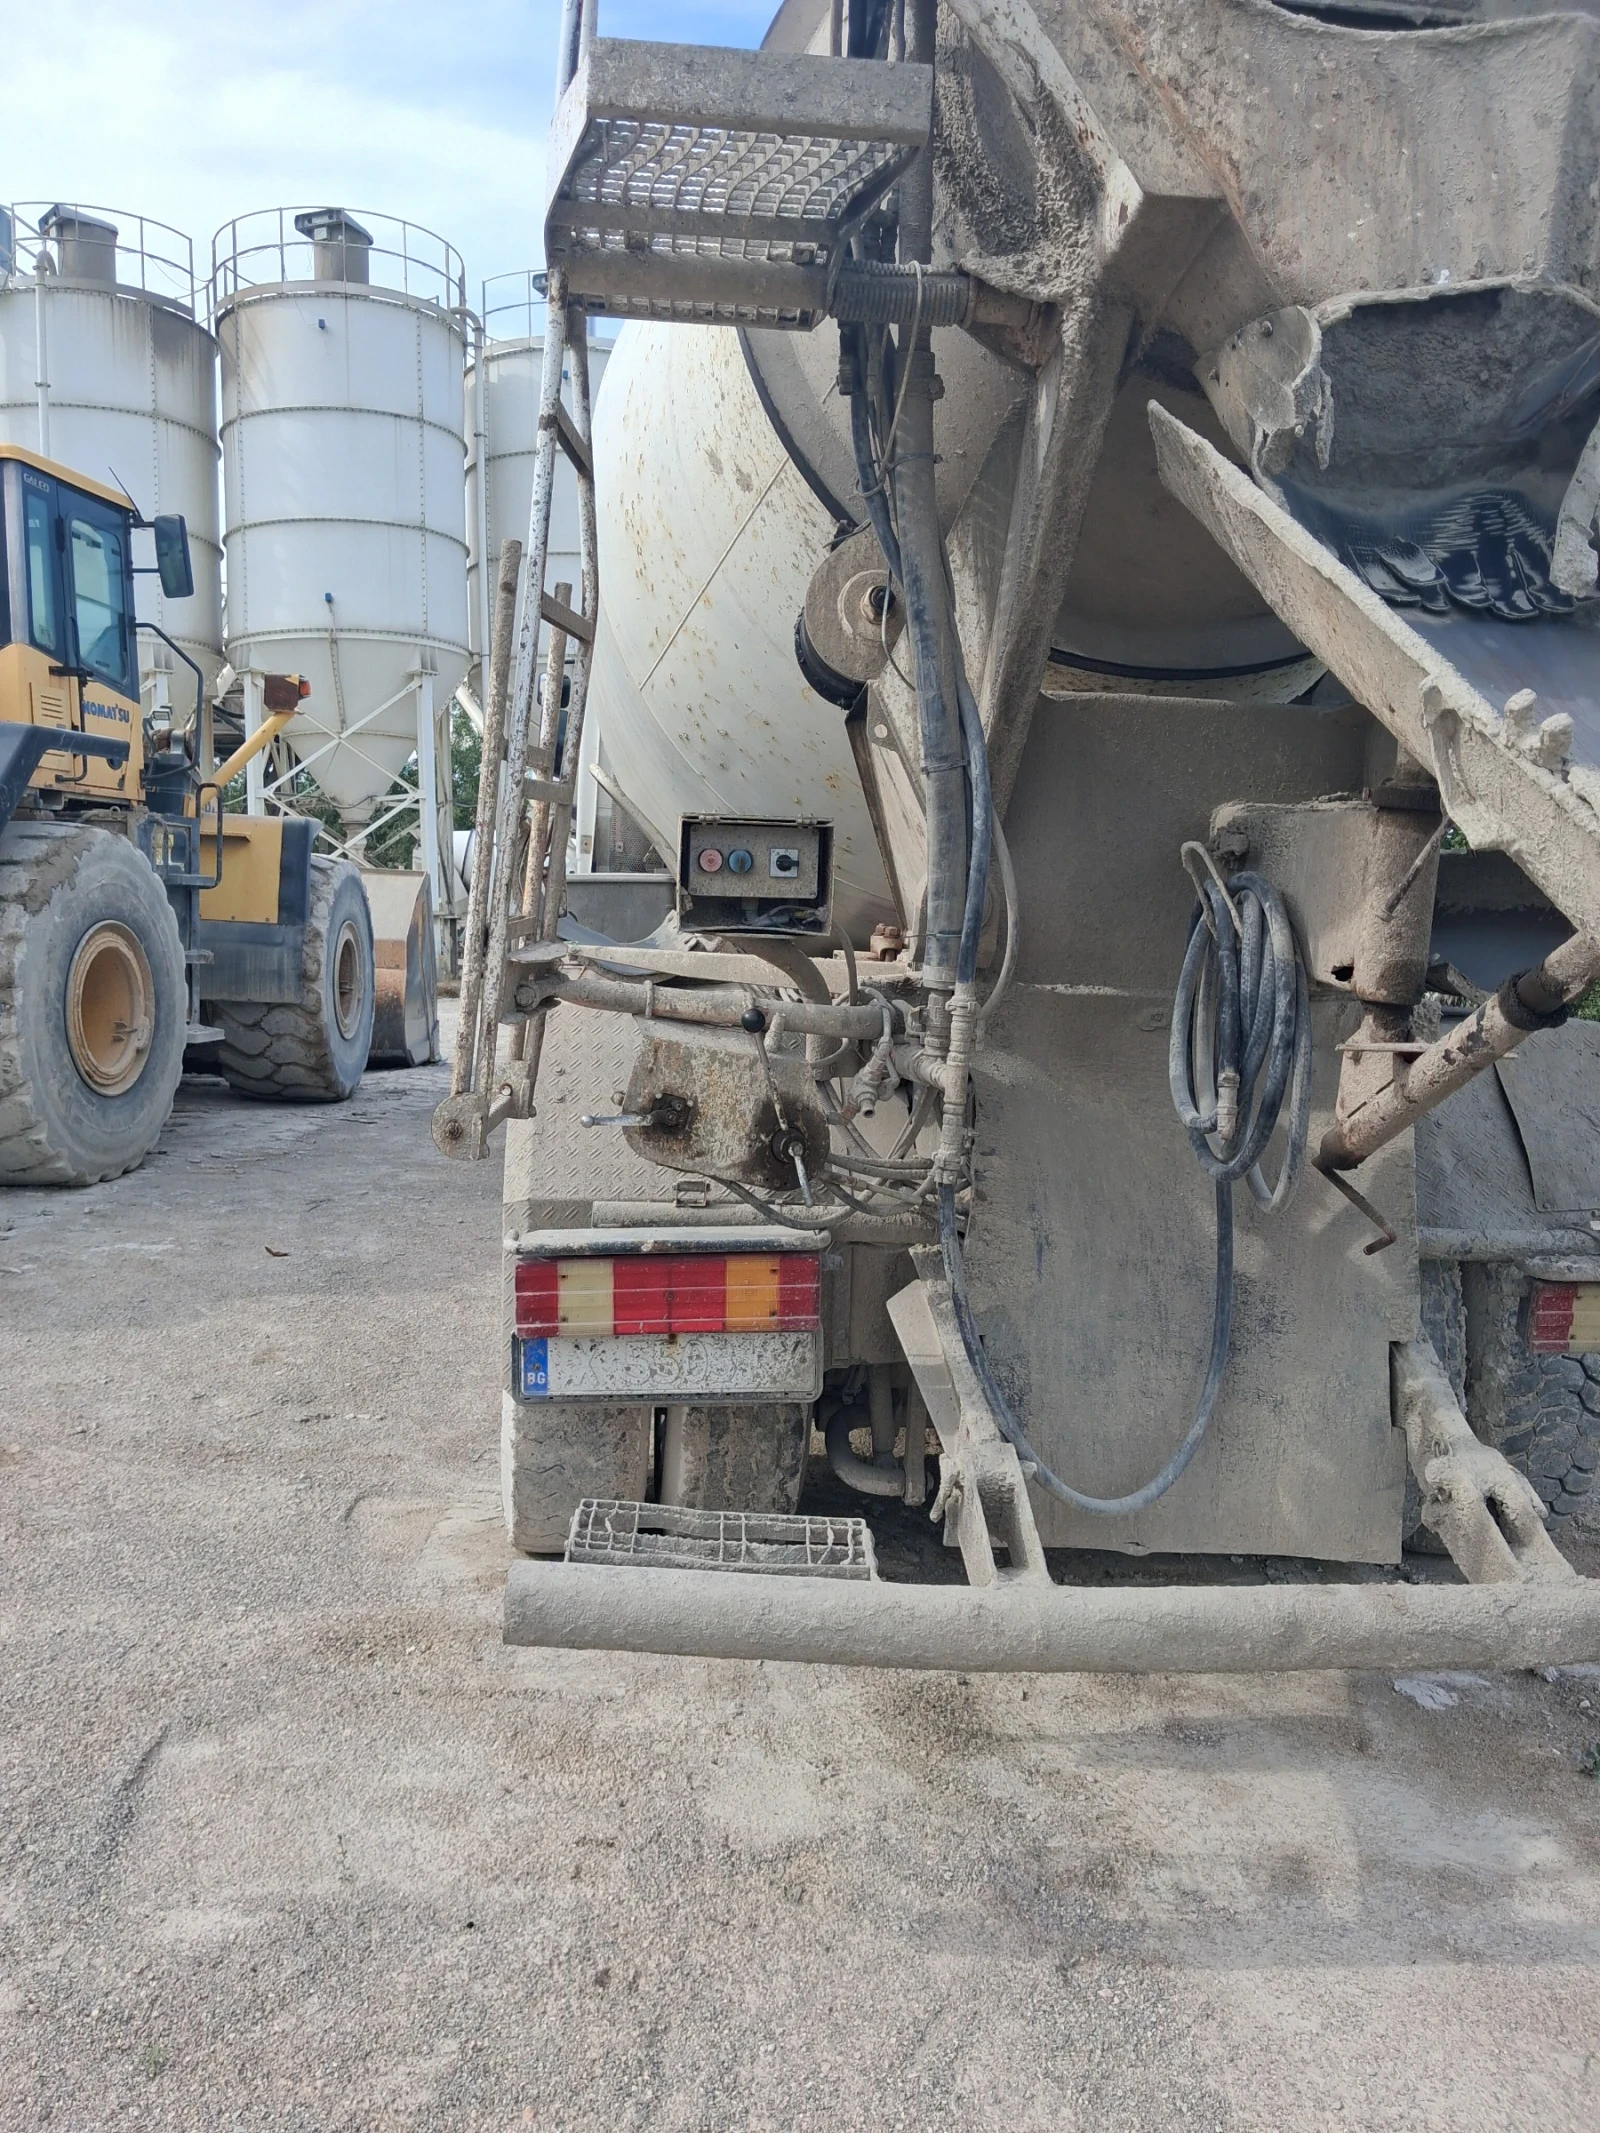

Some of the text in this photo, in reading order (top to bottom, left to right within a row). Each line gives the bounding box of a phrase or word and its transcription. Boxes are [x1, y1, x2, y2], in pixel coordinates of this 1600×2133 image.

[24, 473, 49, 493] GALEO
[82, 700, 130, 724] KOMATSU
[527, 1371, 546, 1385] BG
